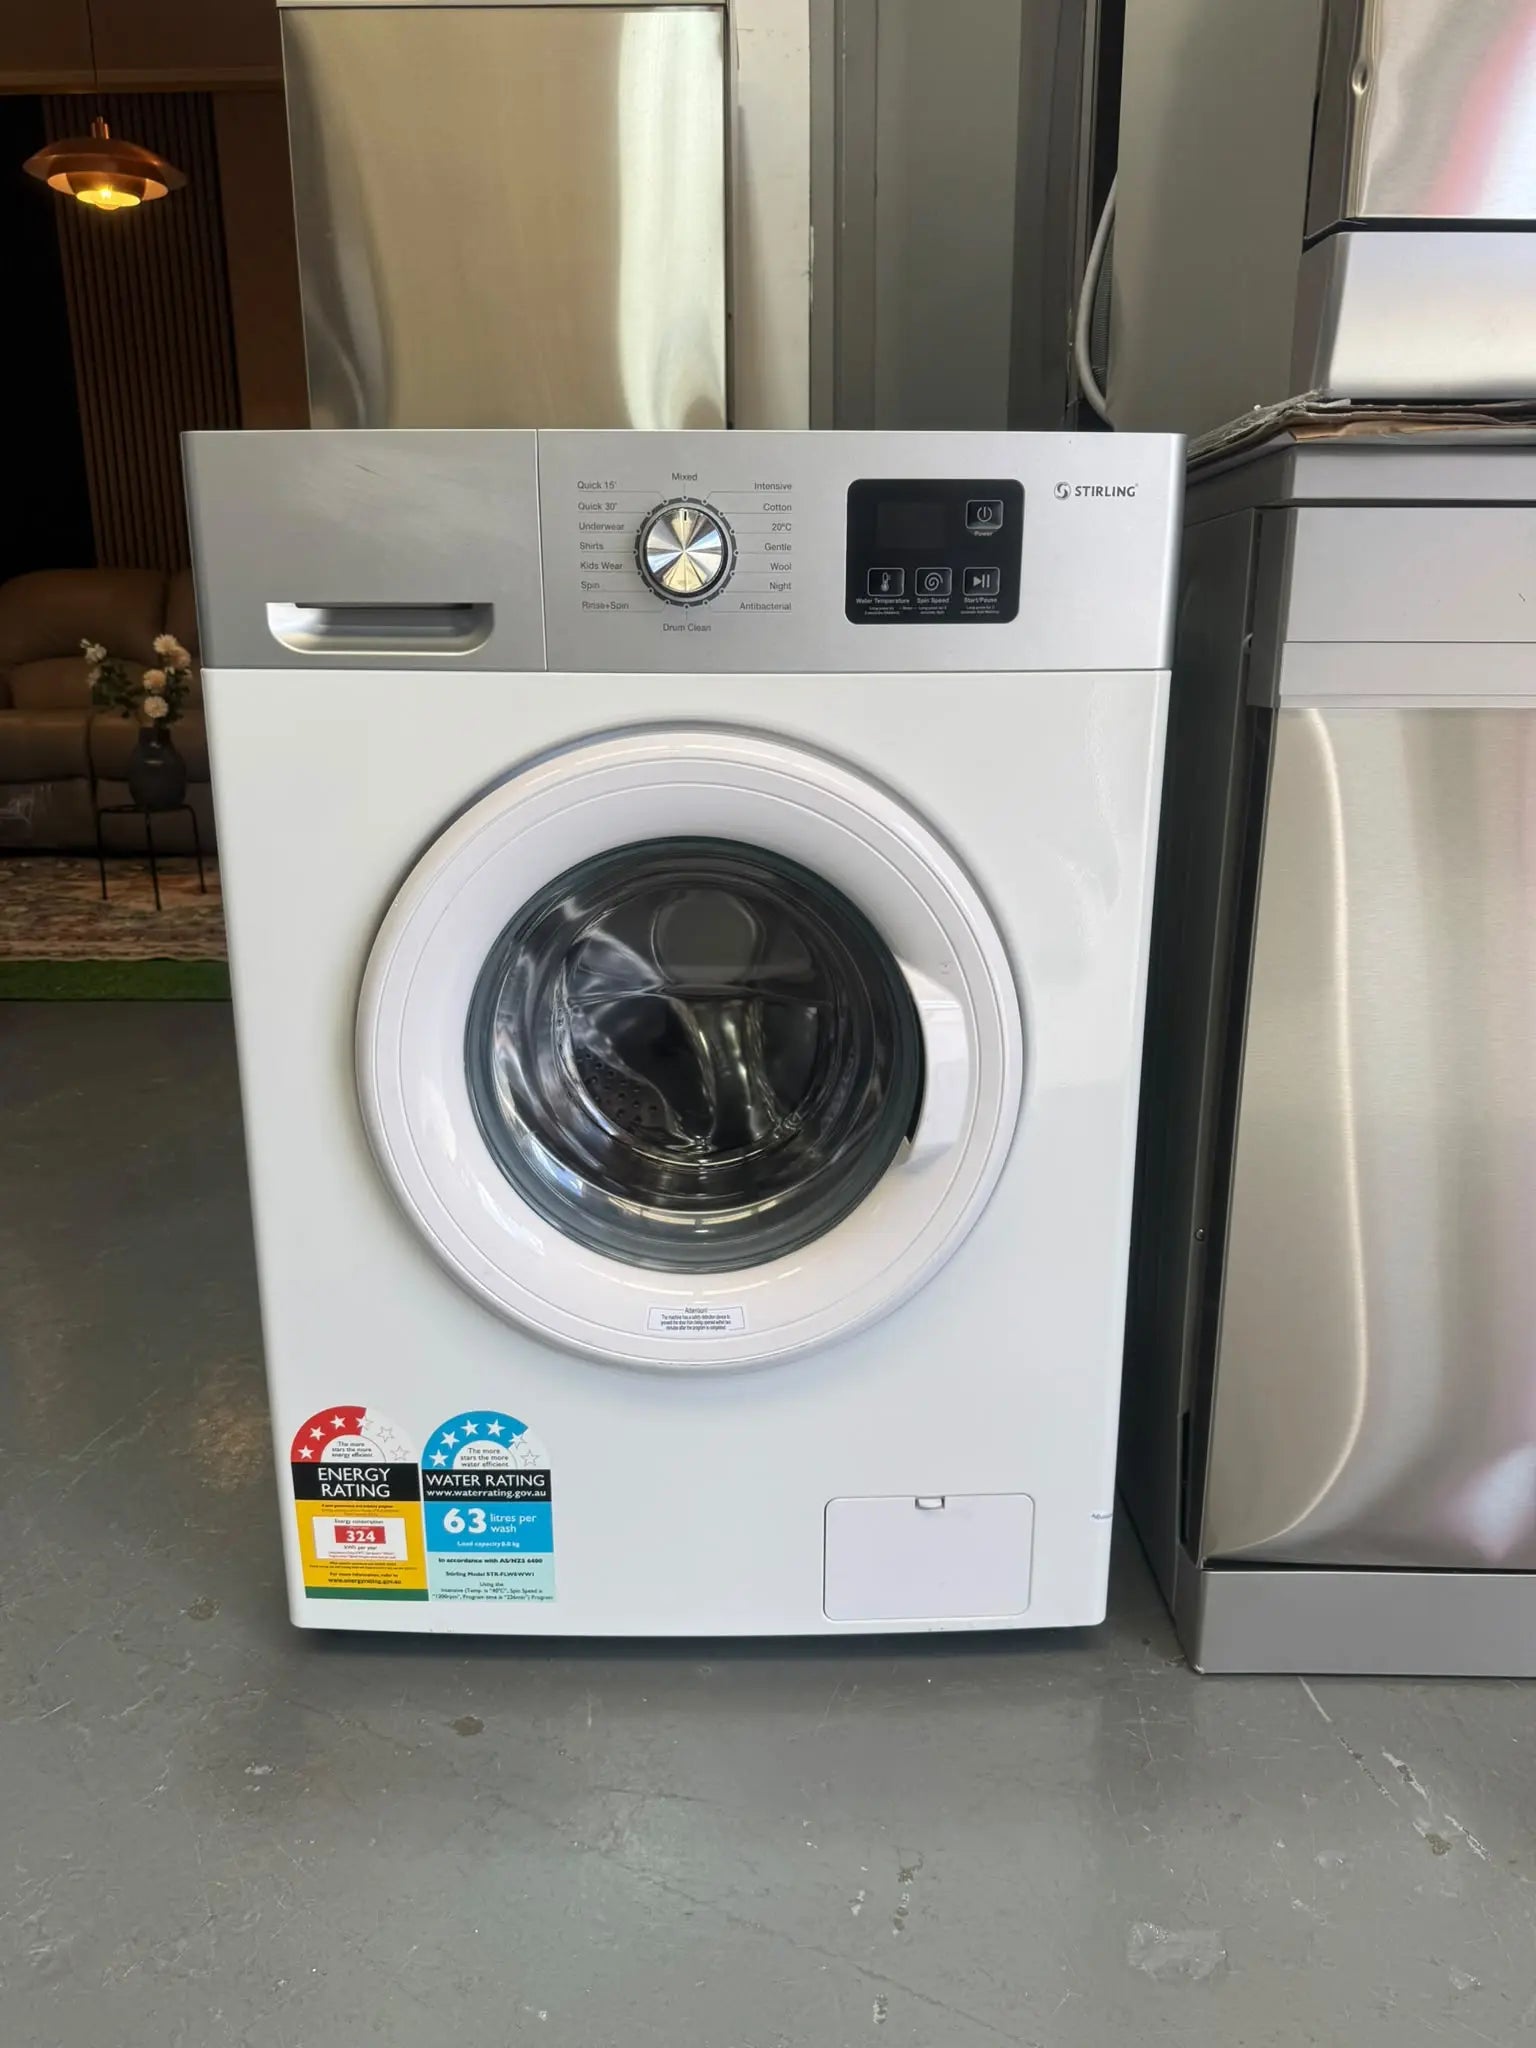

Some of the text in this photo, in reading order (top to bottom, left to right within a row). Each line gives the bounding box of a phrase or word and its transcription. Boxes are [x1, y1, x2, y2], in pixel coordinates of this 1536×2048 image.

[672, 473, 697, 481] Mixed
[578, 481, 602, 490] Quick
[755, 482, 792, 490] Intensive
[1075, 486, 1136, 497] STIRLING
[764, 503, 792, 511] Cotton
[579, 522, 624, 531] Underwear
[580, 542, 604, 550] Shirts
[765, 543, 792, 551] Gentle
[581, 562, 599, 570] Kids
[771, 563, 792, 571] Wool
[581, 581, 600, 590] Spin
[770, 582, 792, 591] Night
[582, 602, 629, 611] Rinse+Spin
[318, 1467, 391, 1481] ENERGY
[427, 1474, 545, 1487] WATER RATING
[321, 1483, 390, 1498] RATING
[427, 1489, 546, 1499] www.waterrating.gov.au
[443, 1508, 486, 1534] 63
[490, 1513, 537, 1524] litres per
[490, 1523, 516, 1533] wash
[346, 1530, 376, 1543] 324
